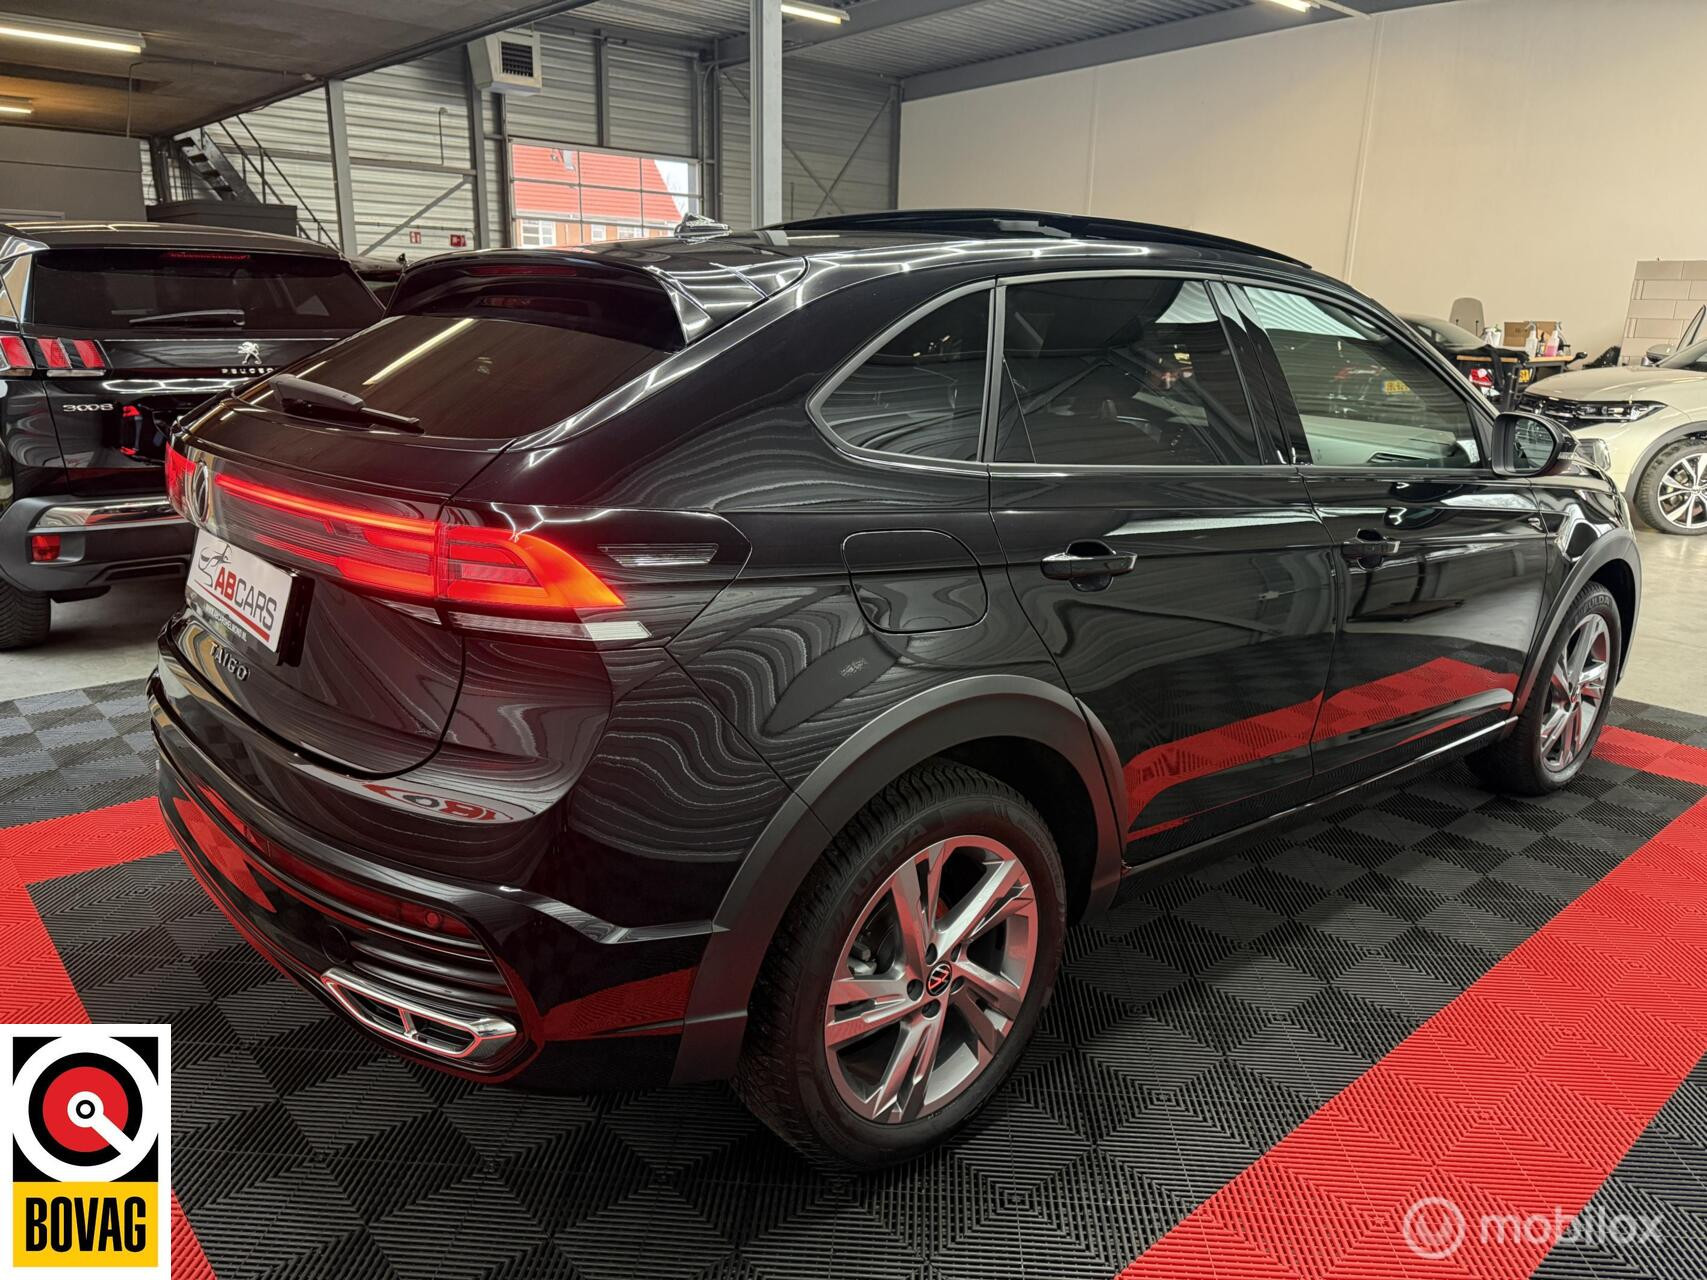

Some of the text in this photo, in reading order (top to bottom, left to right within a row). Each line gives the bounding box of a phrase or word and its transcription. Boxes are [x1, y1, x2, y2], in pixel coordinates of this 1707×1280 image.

[221, 367, 276, 375] PEUGEO
[62, 403, 114, 412] 3008
[213, 566, 277, 632] ABCARS
[209, 642, 249, 681] TAIGO
